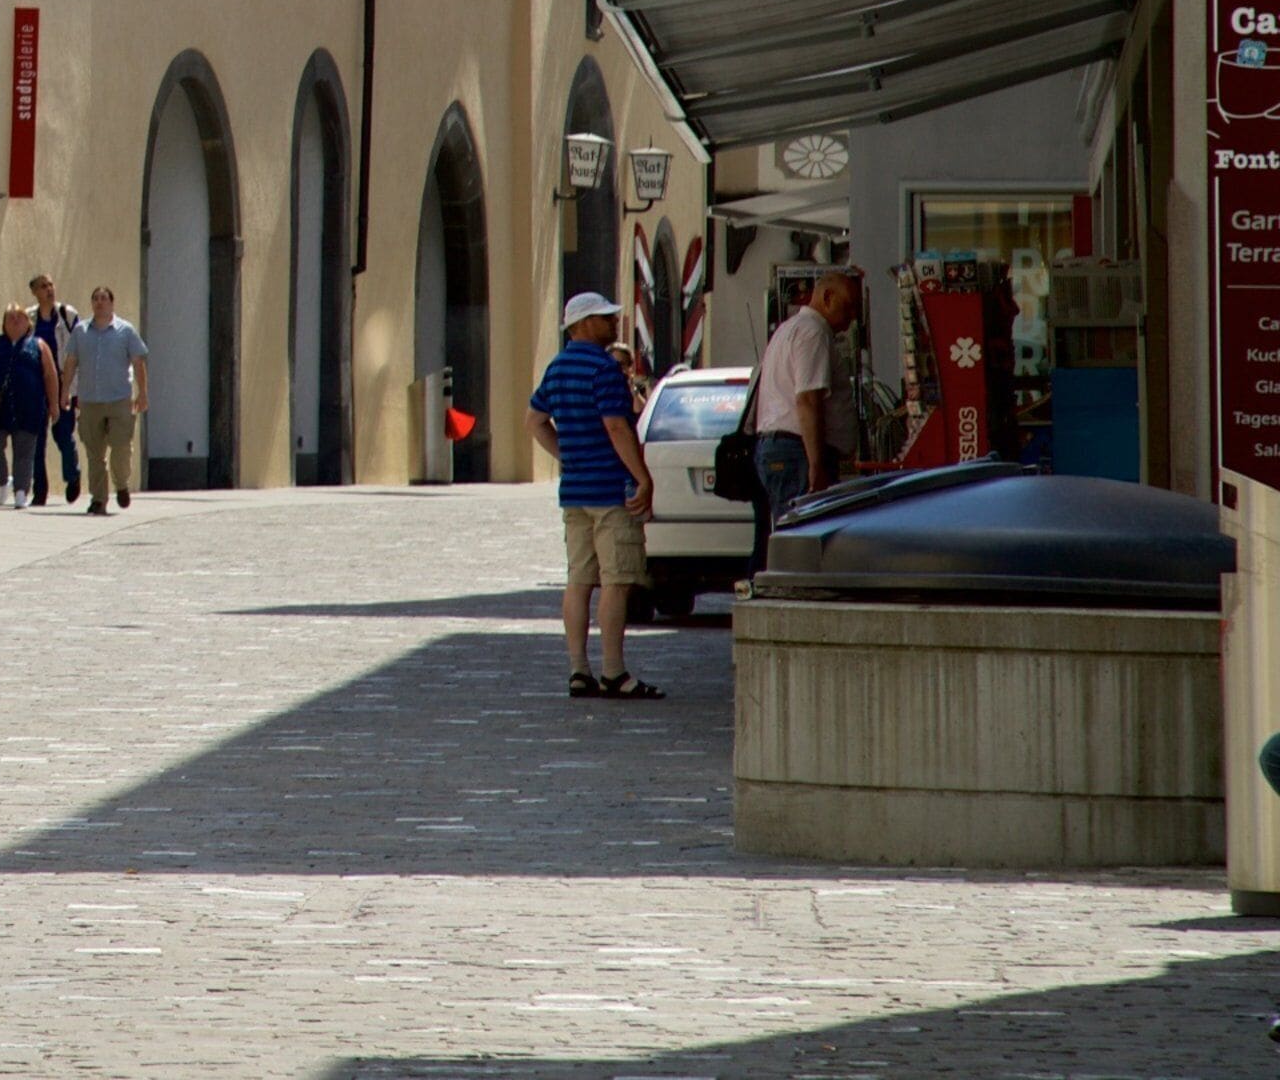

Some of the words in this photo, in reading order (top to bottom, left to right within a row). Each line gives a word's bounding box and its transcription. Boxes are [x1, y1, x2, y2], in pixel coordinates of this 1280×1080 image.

[1231, 6, 1280, 35] Ca
[17, 23, 36, 120] stadtgalerie
[1231, 209, 1280, 231] Gar
[1232, 410, 1280, 429] Tages
